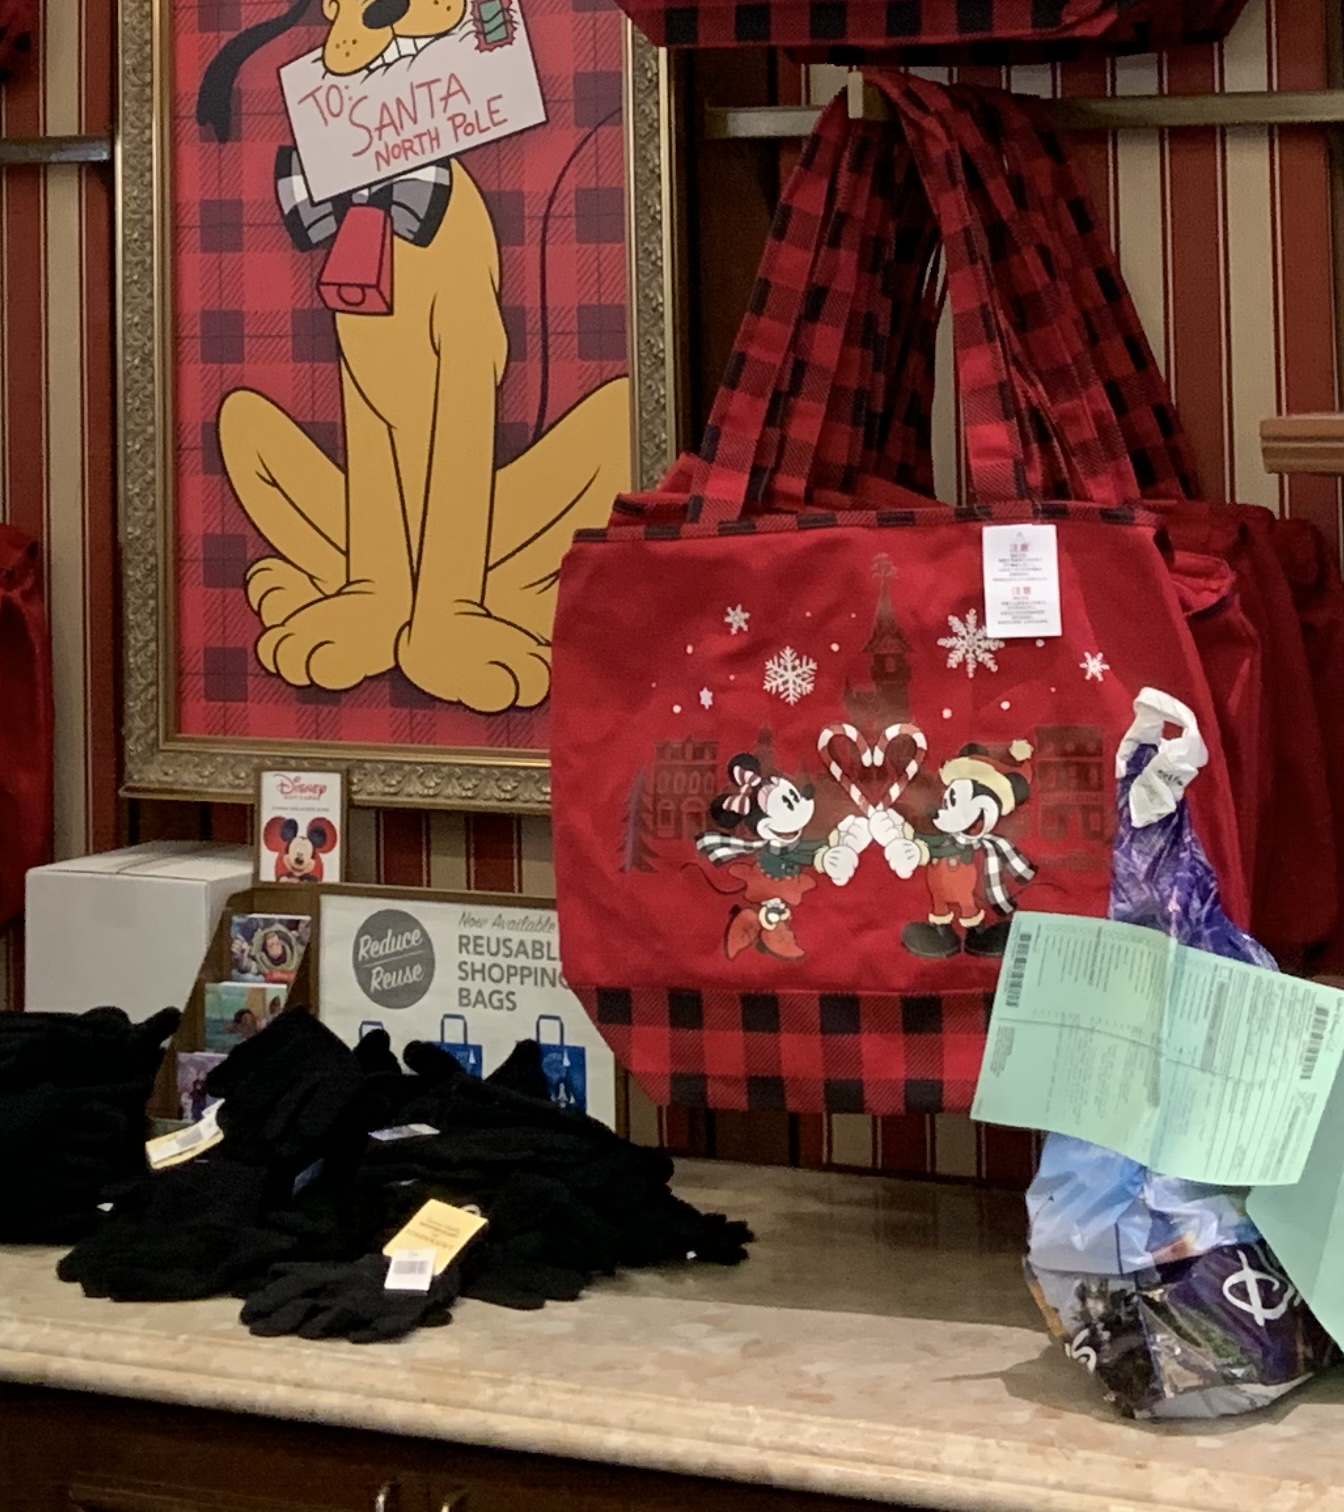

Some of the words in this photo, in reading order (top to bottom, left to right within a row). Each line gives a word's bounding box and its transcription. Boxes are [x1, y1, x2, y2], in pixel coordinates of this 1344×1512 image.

[297, 84, 353, 126] TO:
[348, 72, 471, 158] SANTA
[374, 127, 441, 172] NORTH
[272, 773, 327, 799] Disney
[458, 911, 488, 929] Now
[491, 913, 556, 934] Available
[357, 928, 423, 962] Reduce
[458, 934, 560, 962] REUSABL
[370, 964, 424, 993] Reuse
[458, 987, 517, 1011] BAGS
